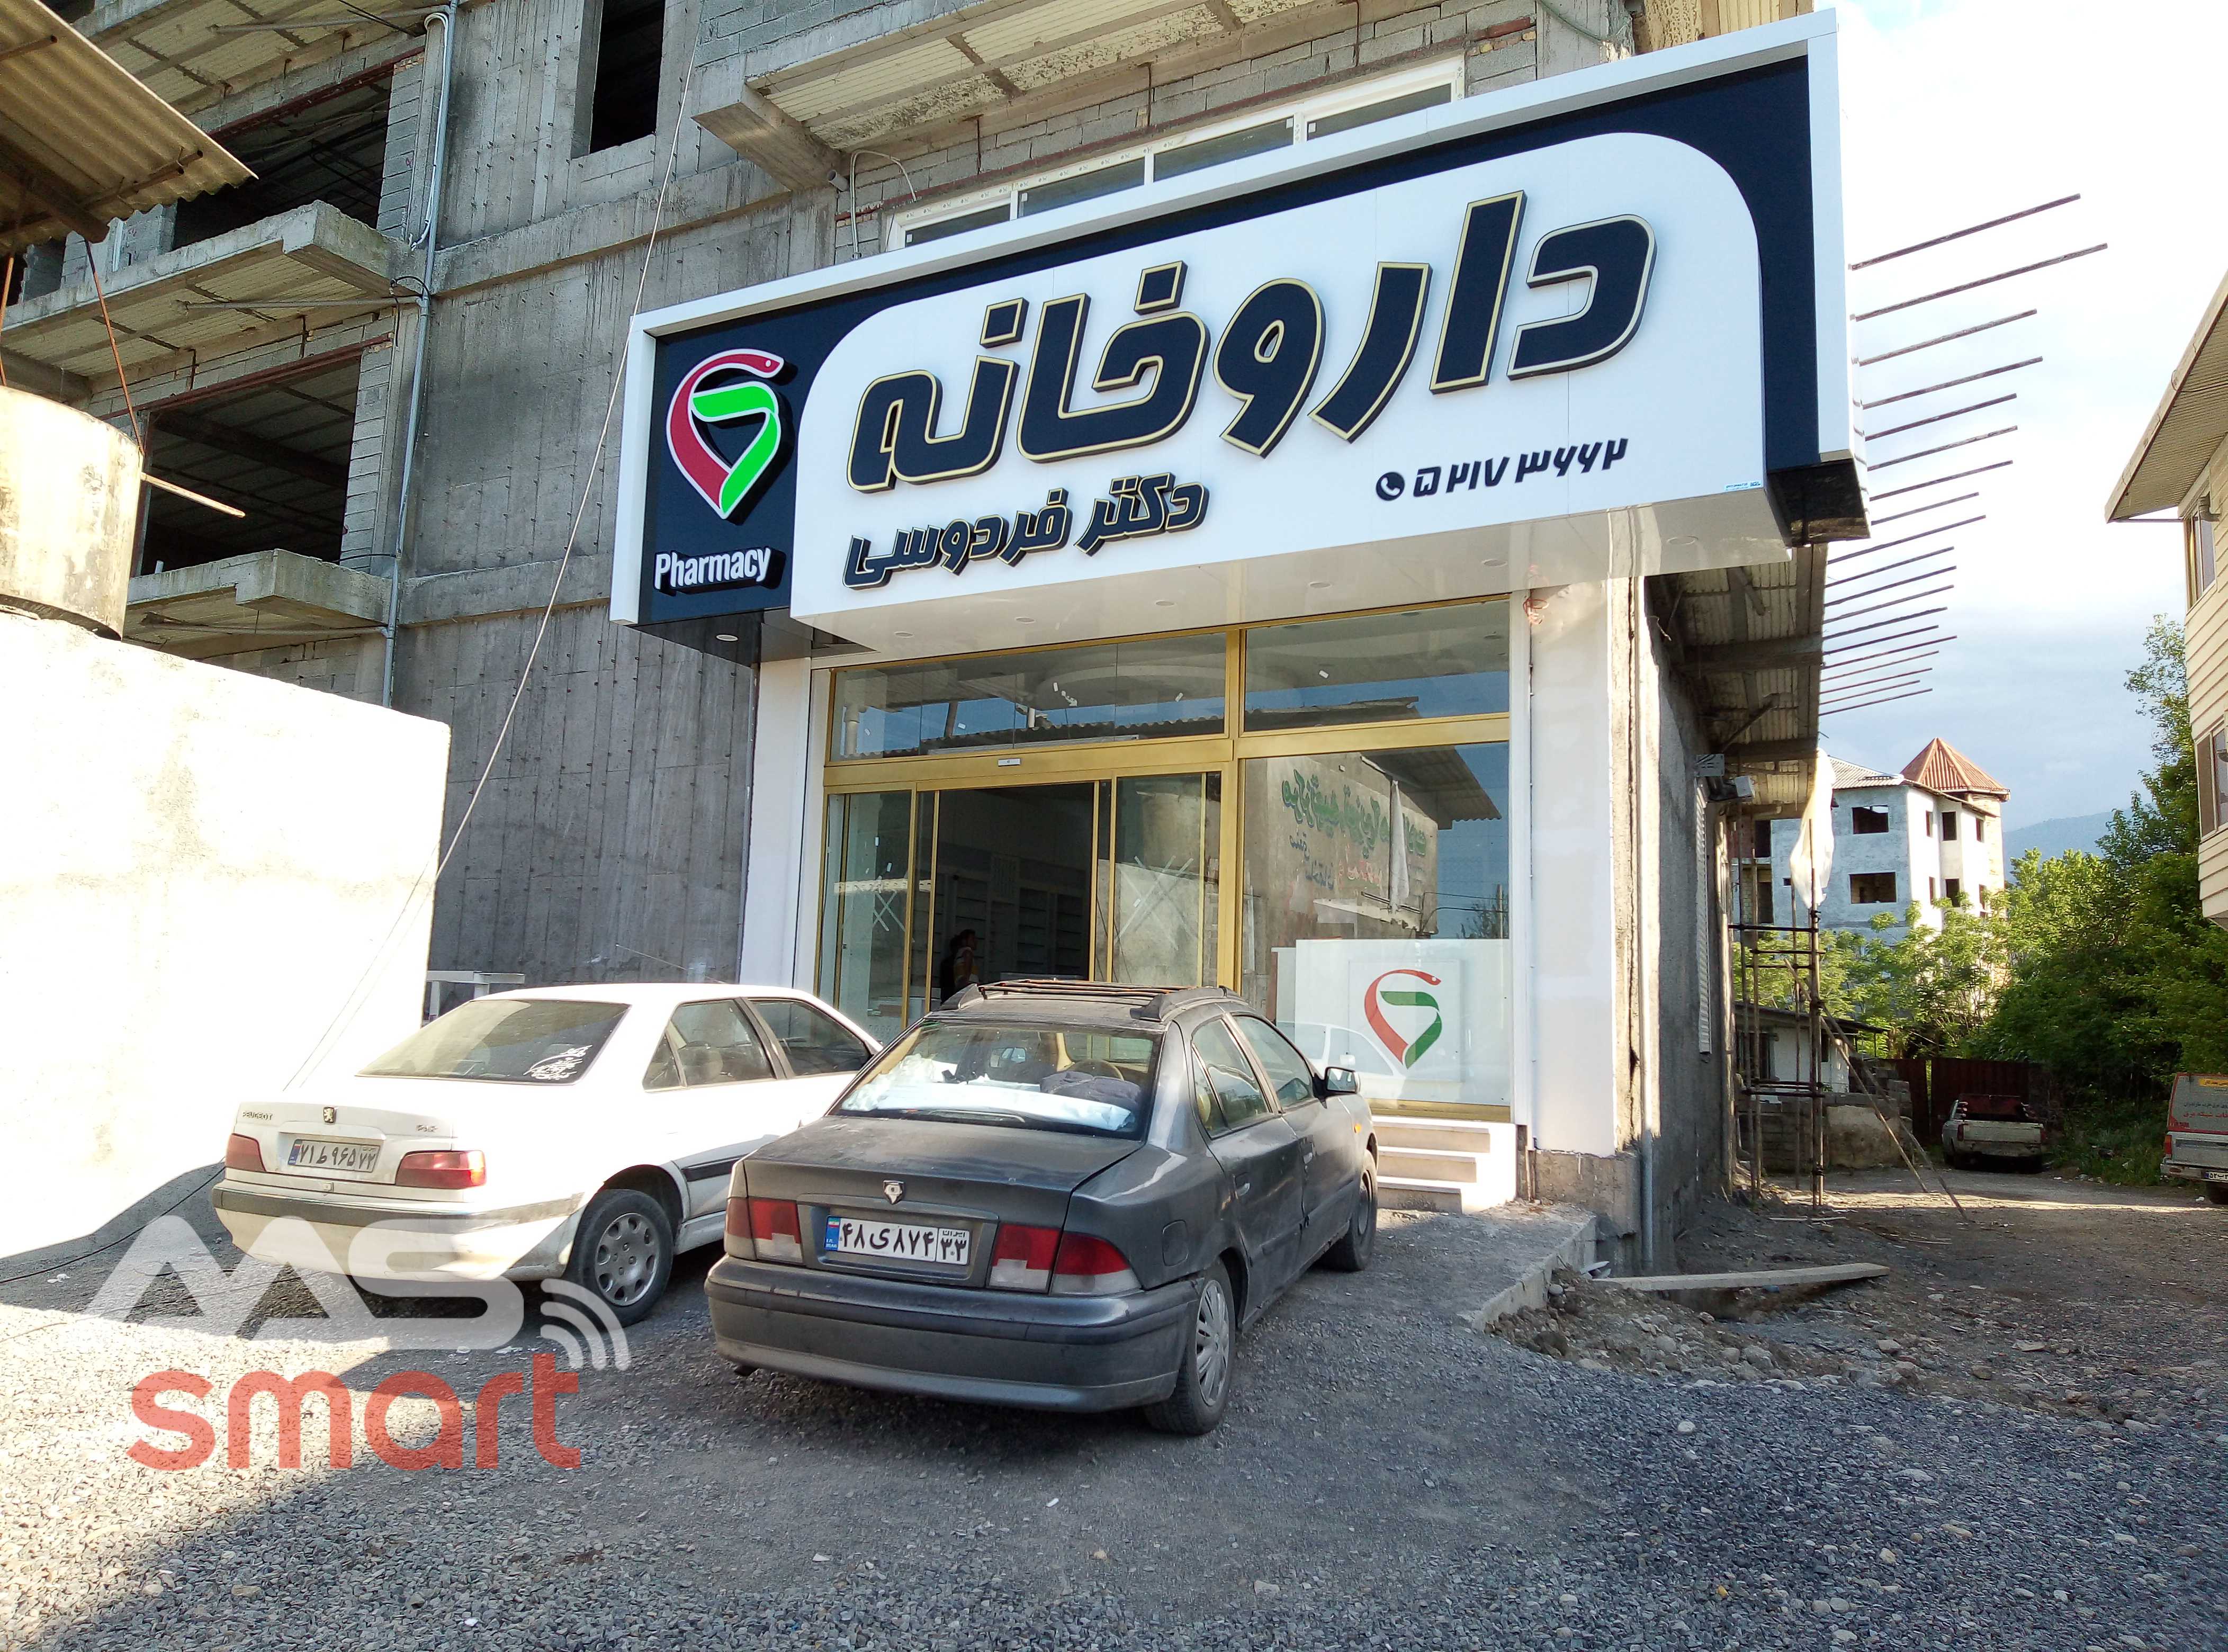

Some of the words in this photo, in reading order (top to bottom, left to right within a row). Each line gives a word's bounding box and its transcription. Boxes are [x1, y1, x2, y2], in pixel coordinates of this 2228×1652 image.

[847, 189, 1657, 493] داروخانه
[843, 487, 1074, 590] فردوسی
[1074, 472, 1209, 556] دکتر
[654, 547, 771, 590] Pharmacy
